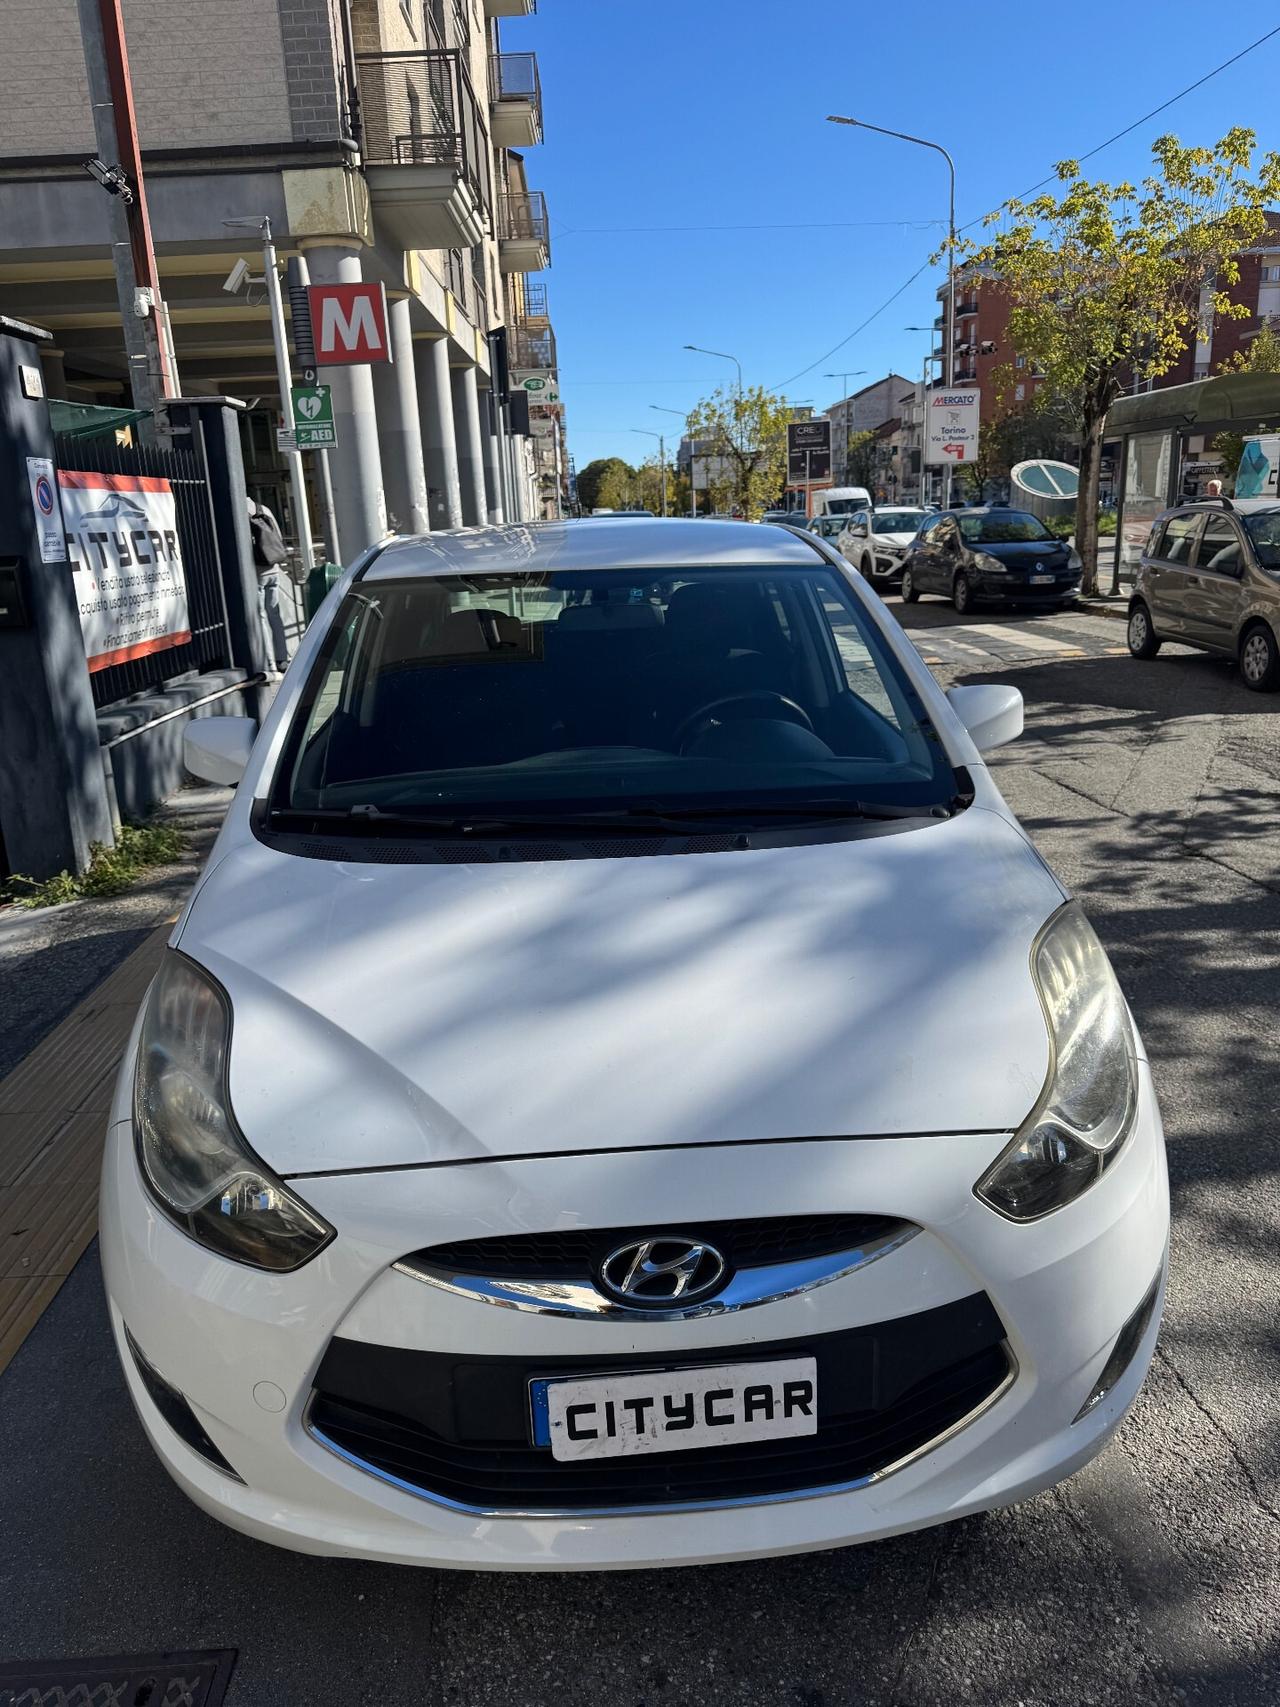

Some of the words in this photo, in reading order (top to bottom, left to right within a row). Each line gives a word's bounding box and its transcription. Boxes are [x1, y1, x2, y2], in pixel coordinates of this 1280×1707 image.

[321, 296, 381, 351] M
[311, 429, 333, 441] AED
[941, 426, 966, 434] Torino
[80, 597, 108, 616] cquisto
[109, 593, 127, 609] usato
[566, 1380, 813, 1440] CITYCAR
